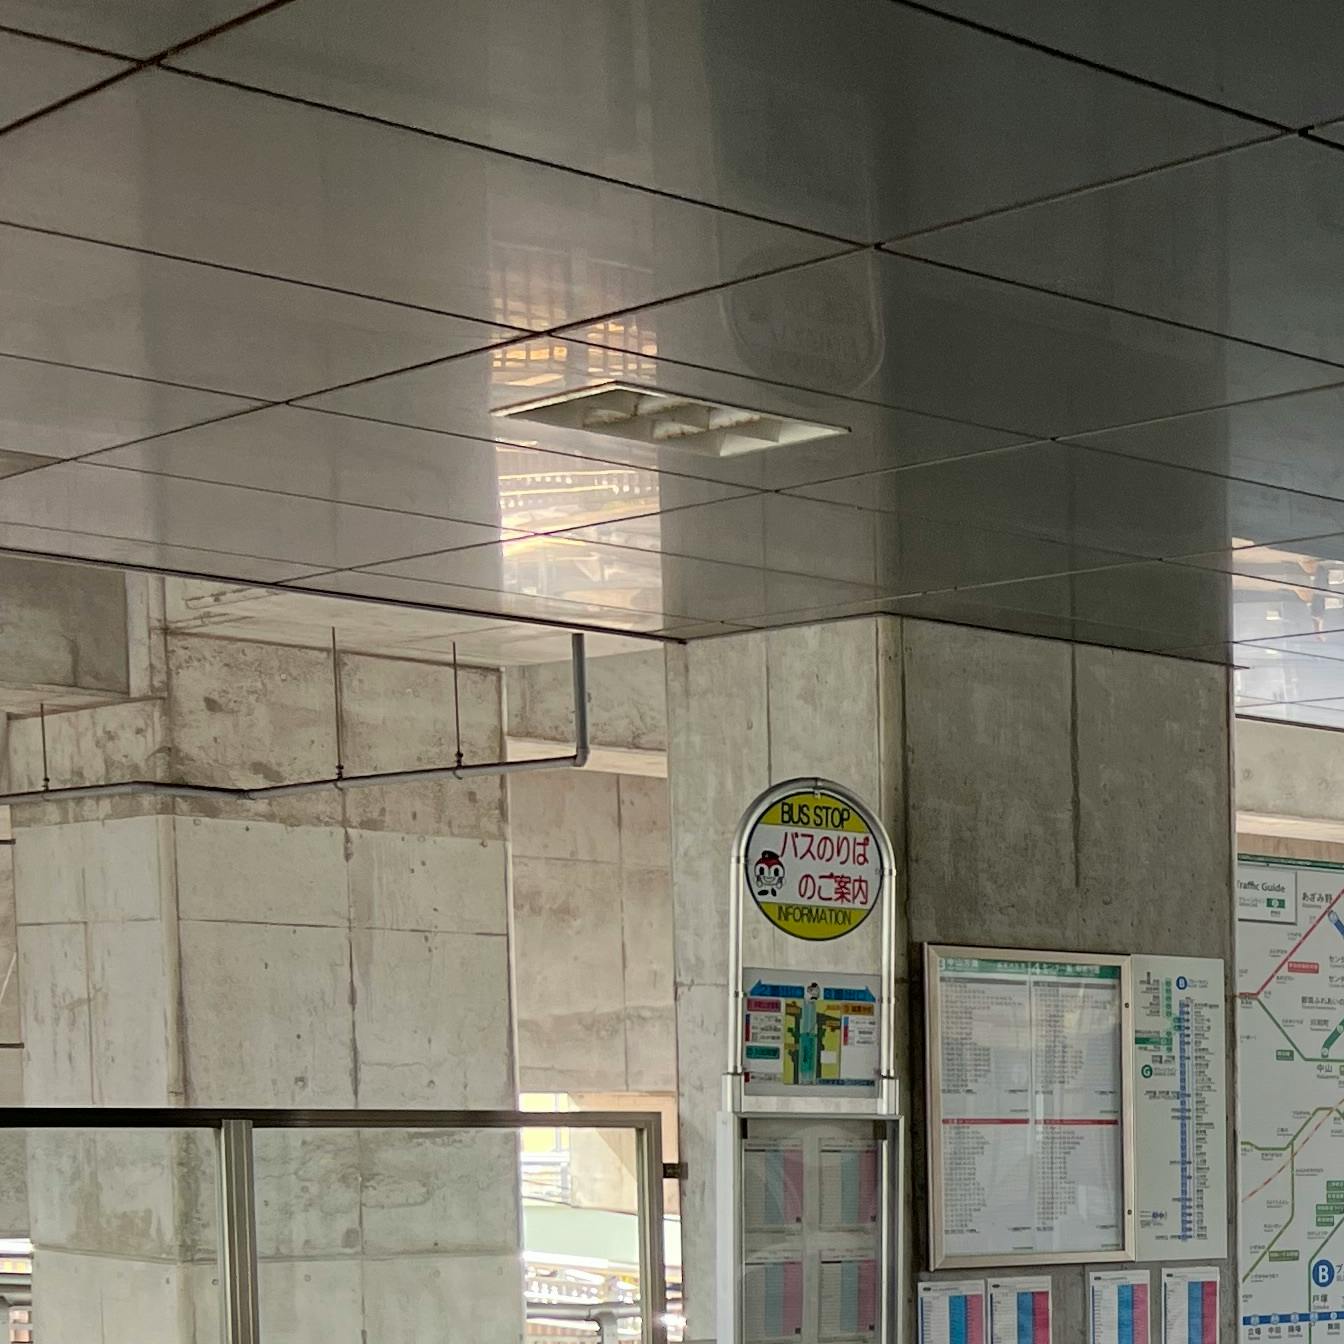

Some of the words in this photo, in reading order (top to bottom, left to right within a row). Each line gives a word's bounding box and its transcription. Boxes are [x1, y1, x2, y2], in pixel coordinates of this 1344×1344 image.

[781, 802, 811, 825] BUS
[814, 805, 851, 829] STOP
[780, 831, 870, 866] バスのりば
[798, 872, 869, 905] のご案内
[1261, 881, 1286, 893] Guide
[777, 906, 852, 926] INFORMATION
[1316, 1064, 1333, 1073] 中山
